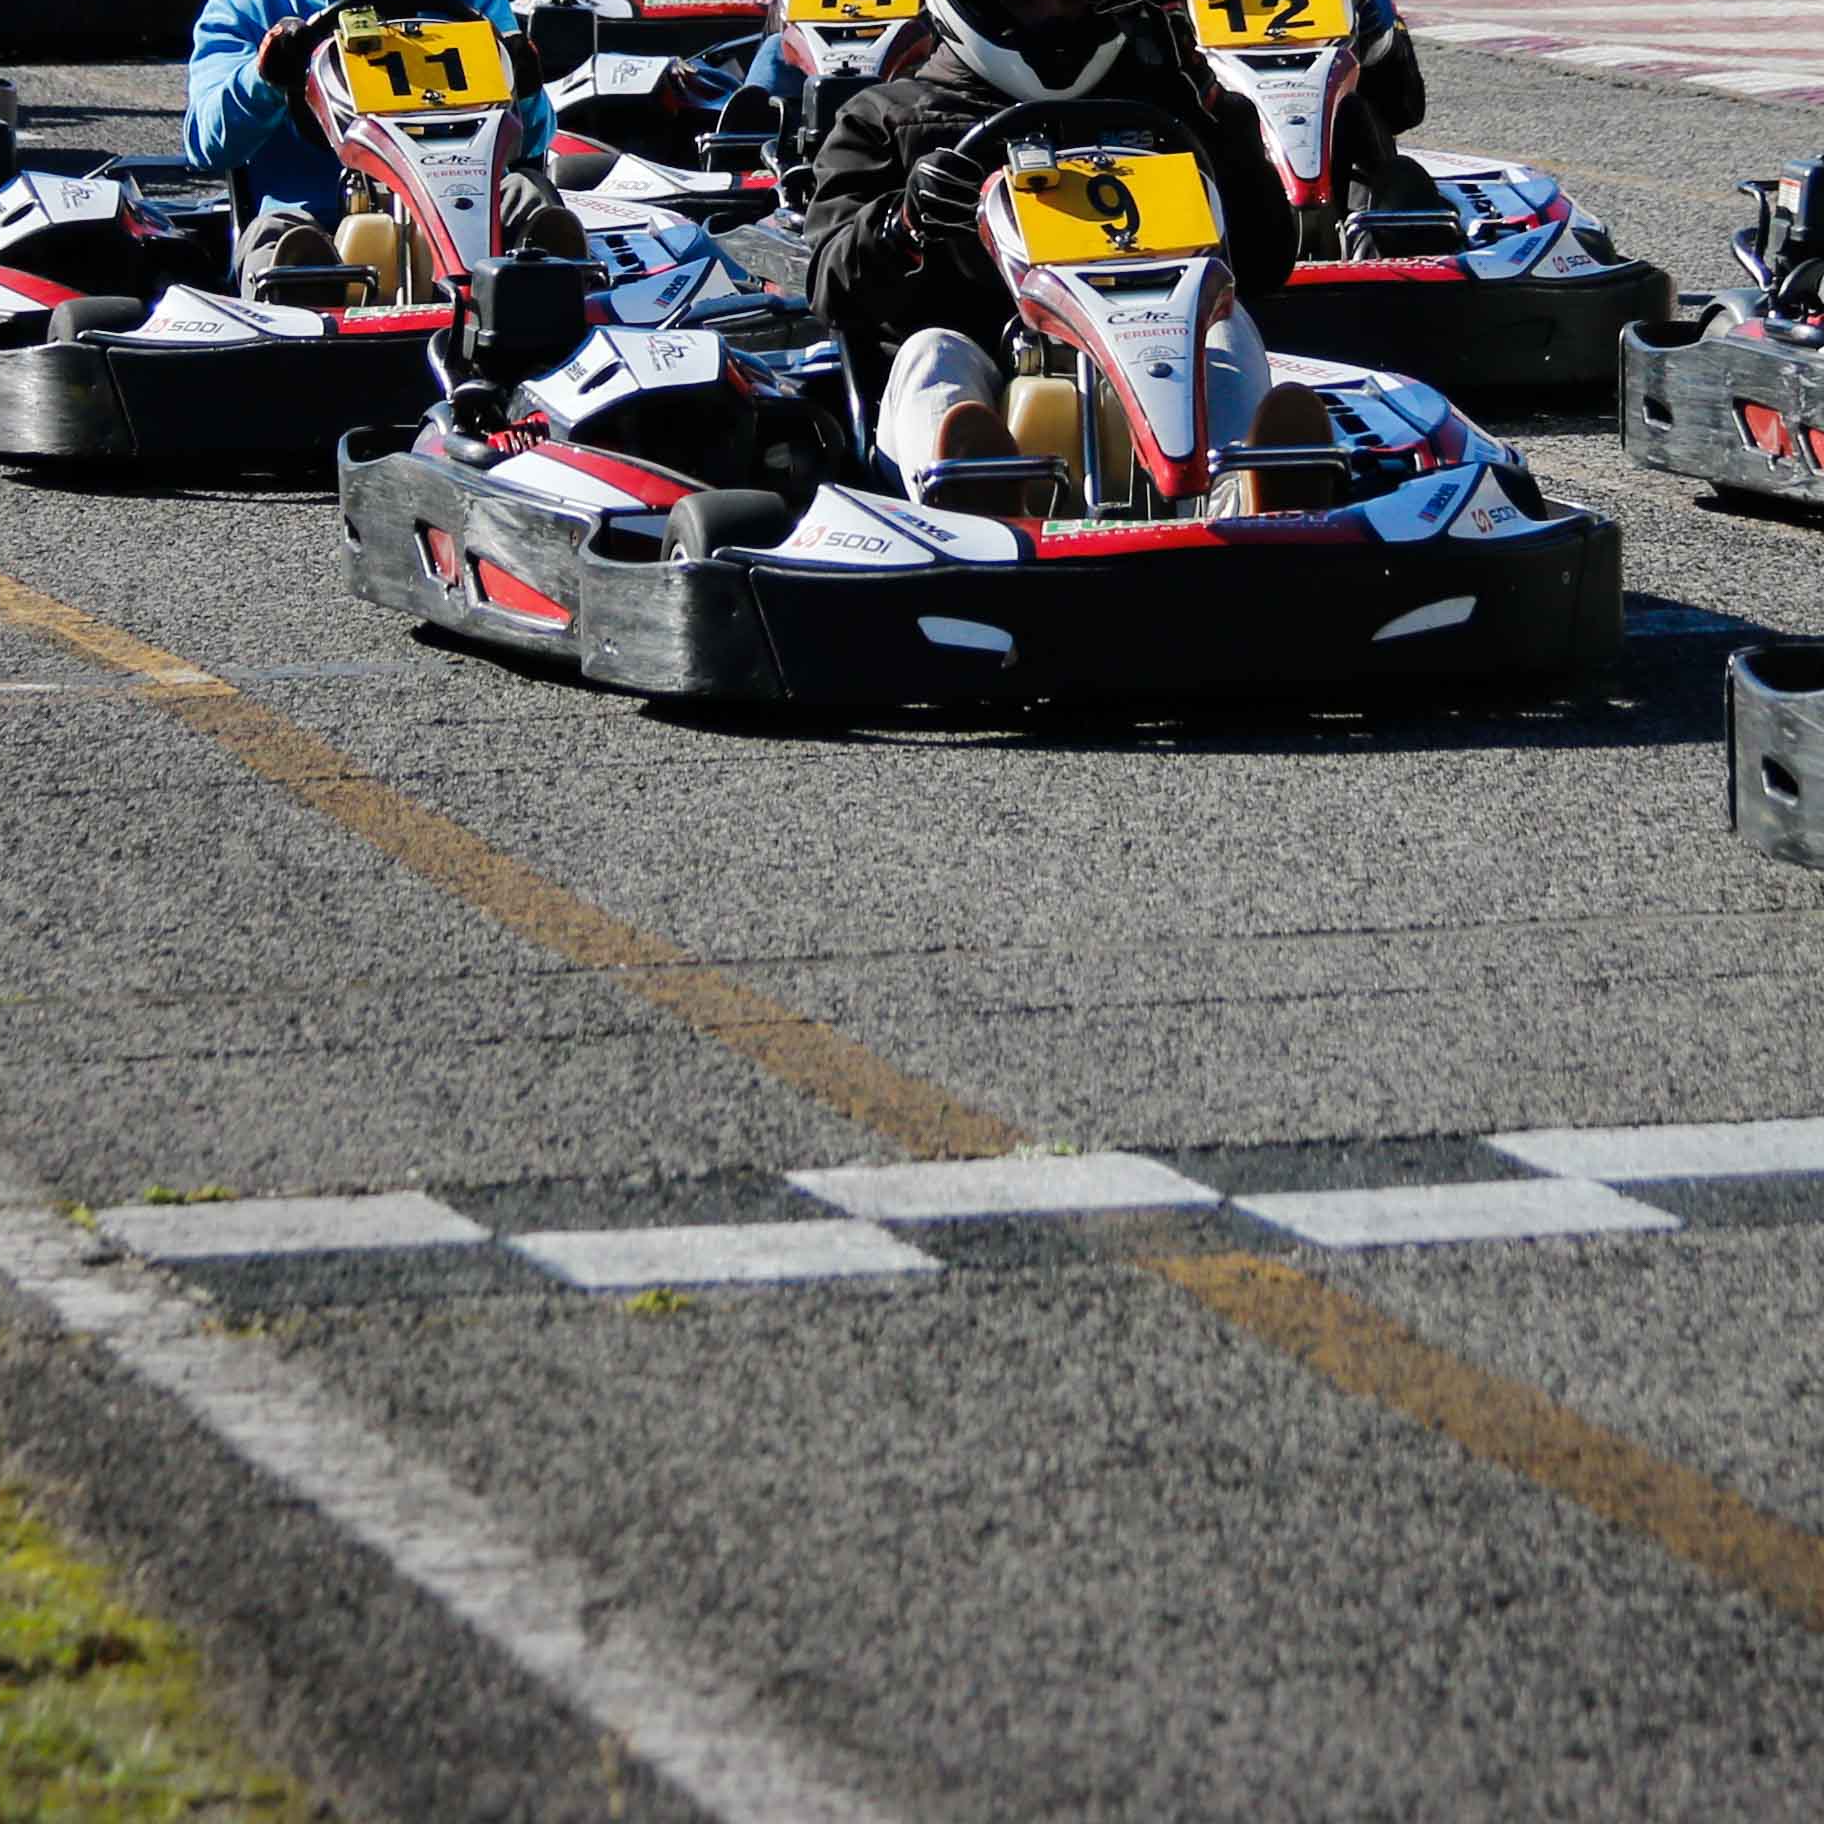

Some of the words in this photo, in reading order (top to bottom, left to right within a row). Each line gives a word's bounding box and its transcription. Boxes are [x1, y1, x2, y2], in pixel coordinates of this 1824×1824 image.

[367, 46, 470, 98] 11
[1086, 172, 1141, 244] 9
[167, 319, 225, 336] SODI
[823, 531, 892, 555] SODI
